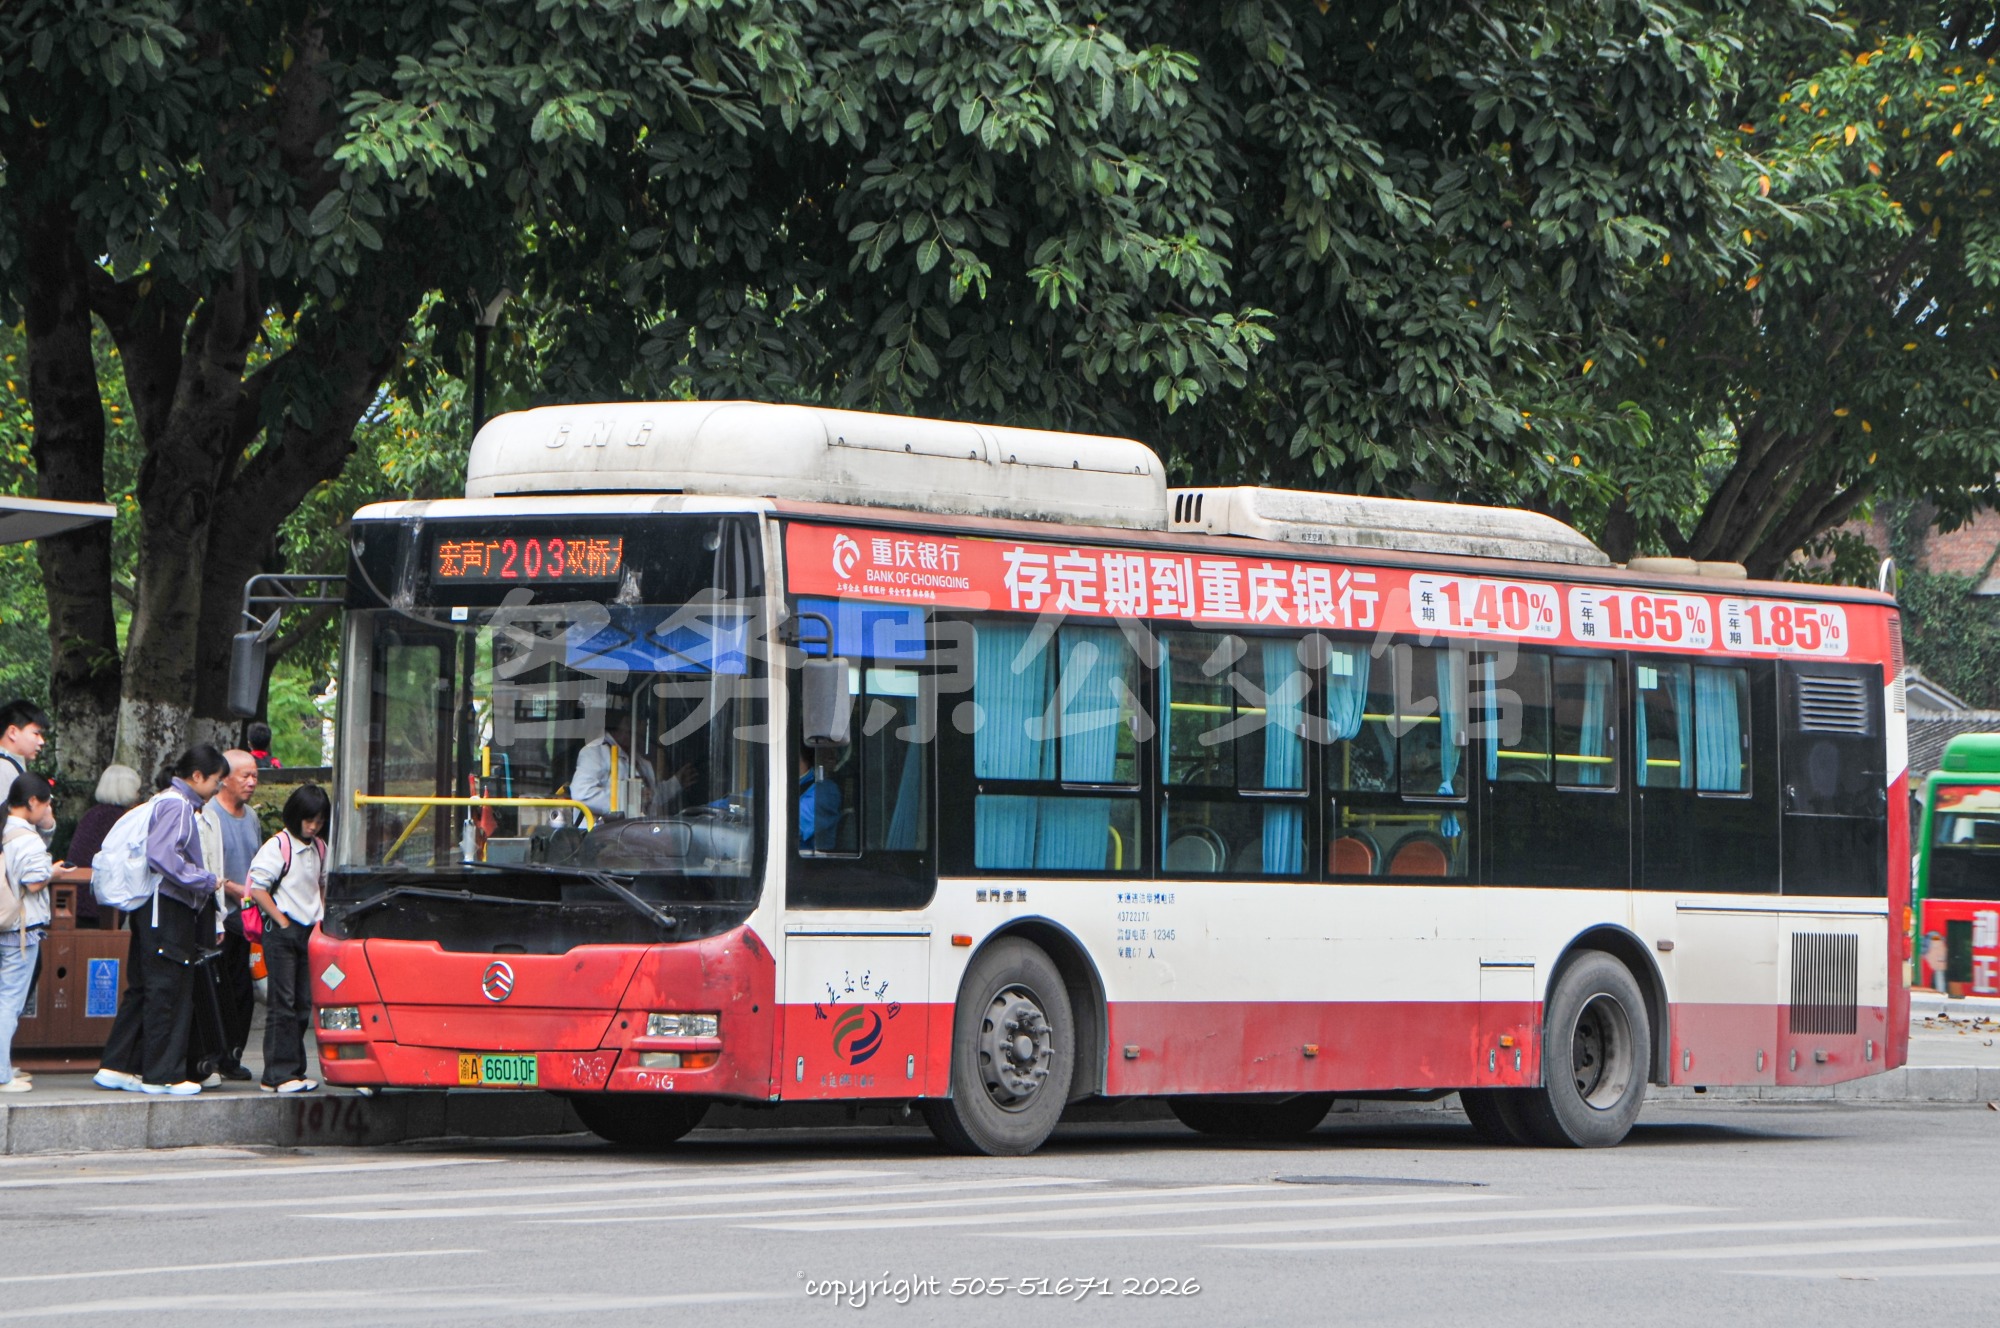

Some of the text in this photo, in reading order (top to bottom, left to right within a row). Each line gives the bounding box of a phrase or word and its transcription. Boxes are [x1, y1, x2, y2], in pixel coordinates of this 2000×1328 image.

[501, 538, 566, 578] 203
[871, 537, 960, 572] 重庆银行
[866, 568, 970, 589] BANK OF CHONGQING
[1002, 546, 1379, 628] 存定期到重庆银行
[1419, 580, 1436, 622] 一年期
[1439, 581, 1554, 631] 1.40%
[1580, 592, 1595, 636] 二年期
[1599, 595, 1706, 642] 1.65%
[1727, 604, 1742, 644] 三年期
[1744, 605, 1840, 650] 1.85%
[1153, 929, 1176, 941] 12345
